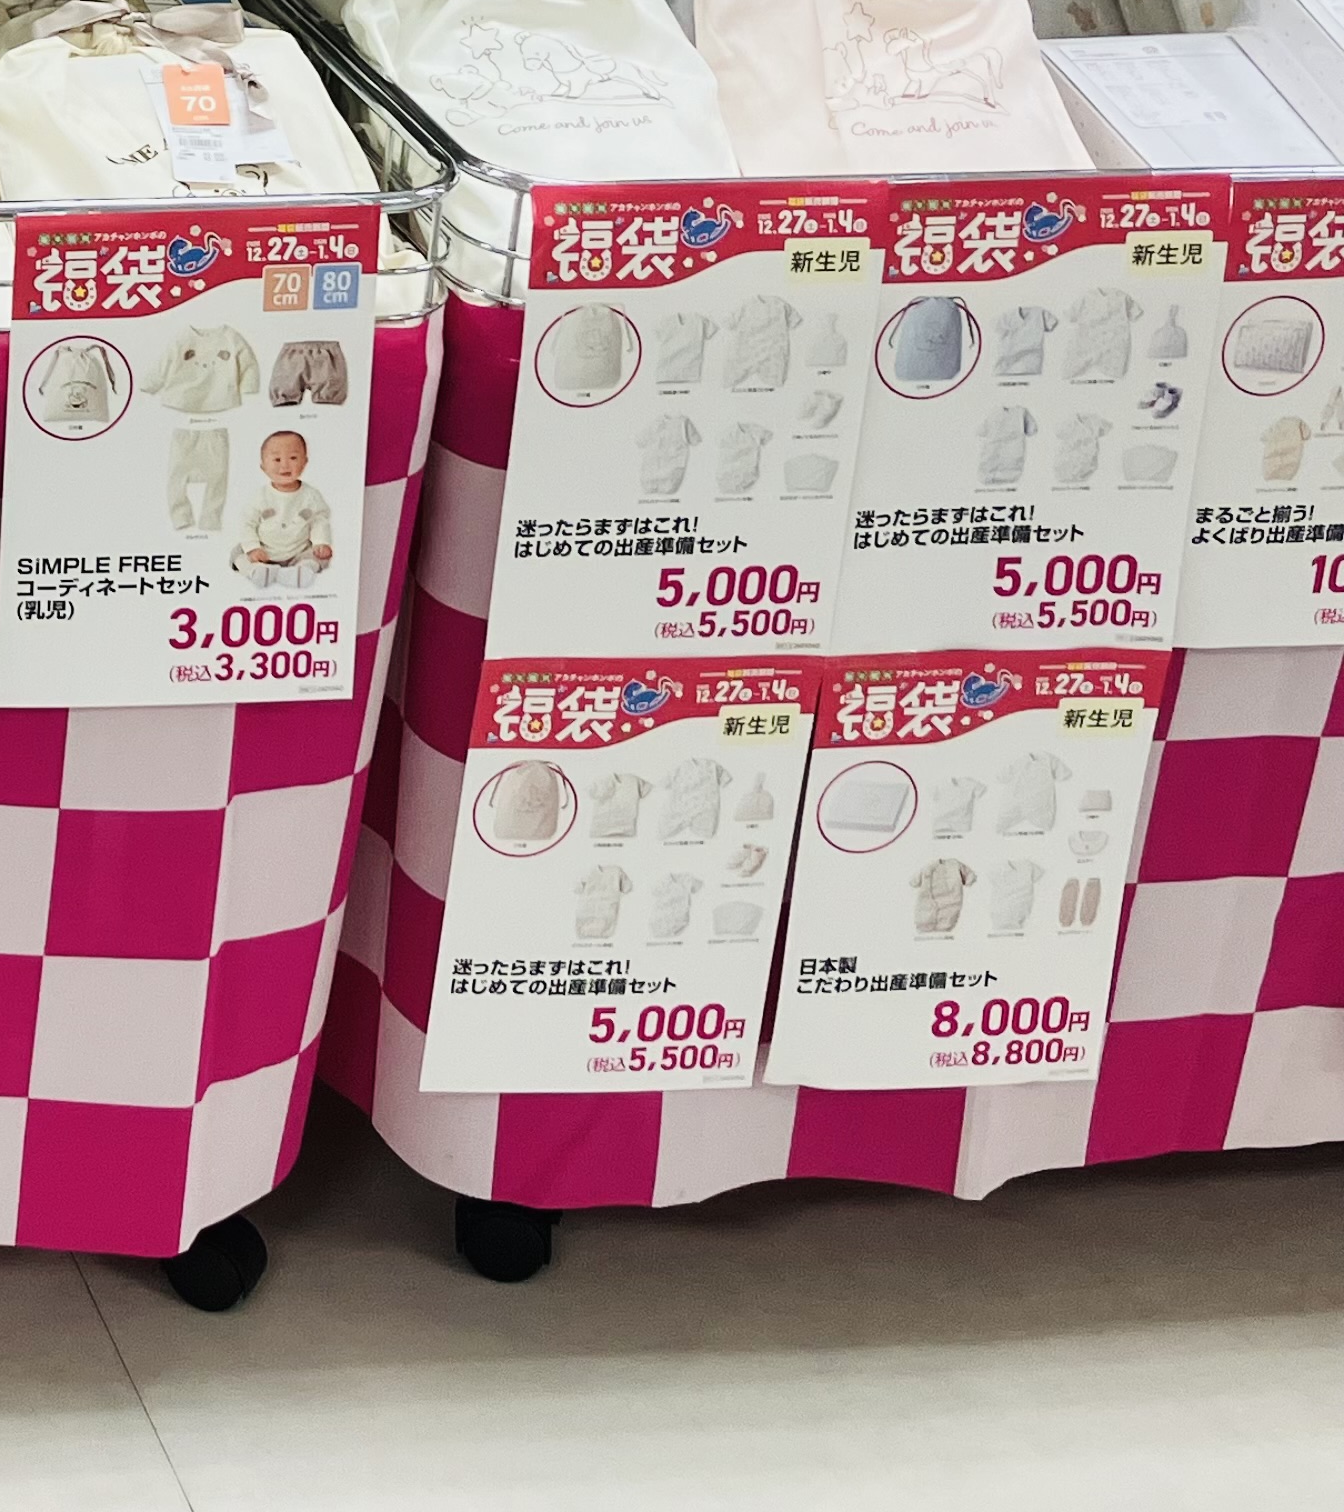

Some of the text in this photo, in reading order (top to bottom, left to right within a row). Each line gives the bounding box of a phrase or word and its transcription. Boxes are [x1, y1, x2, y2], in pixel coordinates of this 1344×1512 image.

[180, 96, 216, 112] 70
[551, 216, 680, 283] 福袋
[893, 211, 1021, 276] 福袋
[1131, 242, 1203, 266] 新生児
[790, 250, 861, 273] 新生児
[34, 245, 166, 312] 福袋
[515, 516, 699, 538] 迷ったらまずはこれ!
[855, 505, 1035, 528] 迷ったらまずはこれ!
[513, 536, 748, 559] はじめての出産準備セット
[853, 524, 1084, 550] はじめての出産準備セット
[118, 555, 182, 573] FREE
[992, 554, 1162, 597] 5,000円
[16, 575, 210, 597] コーディネートセット
[656, 564, 820, 607] 5,000円
[16, 600, 75, 621] (乳児)
[168, 603, 339, 650] 3,000円
[492, 686, 621, 743] 福袋
[836, 681, 962, 740] 福袋
[1063, 708, 1134, 729] 新生児
[722, 715, 791, 737] 新生児
[452, 958, 630, 976] 迷ったらまずはこれ!
[799, 956, 858, 975] 日本製
[450, 977, 677, 996] はじめての出産準備セット
[796, 970, 998, 994] こだわり出産準備セット
[588, 1003, 746, 1044] 5,000円
[930, 996, 1090, 1038] 8,000円
